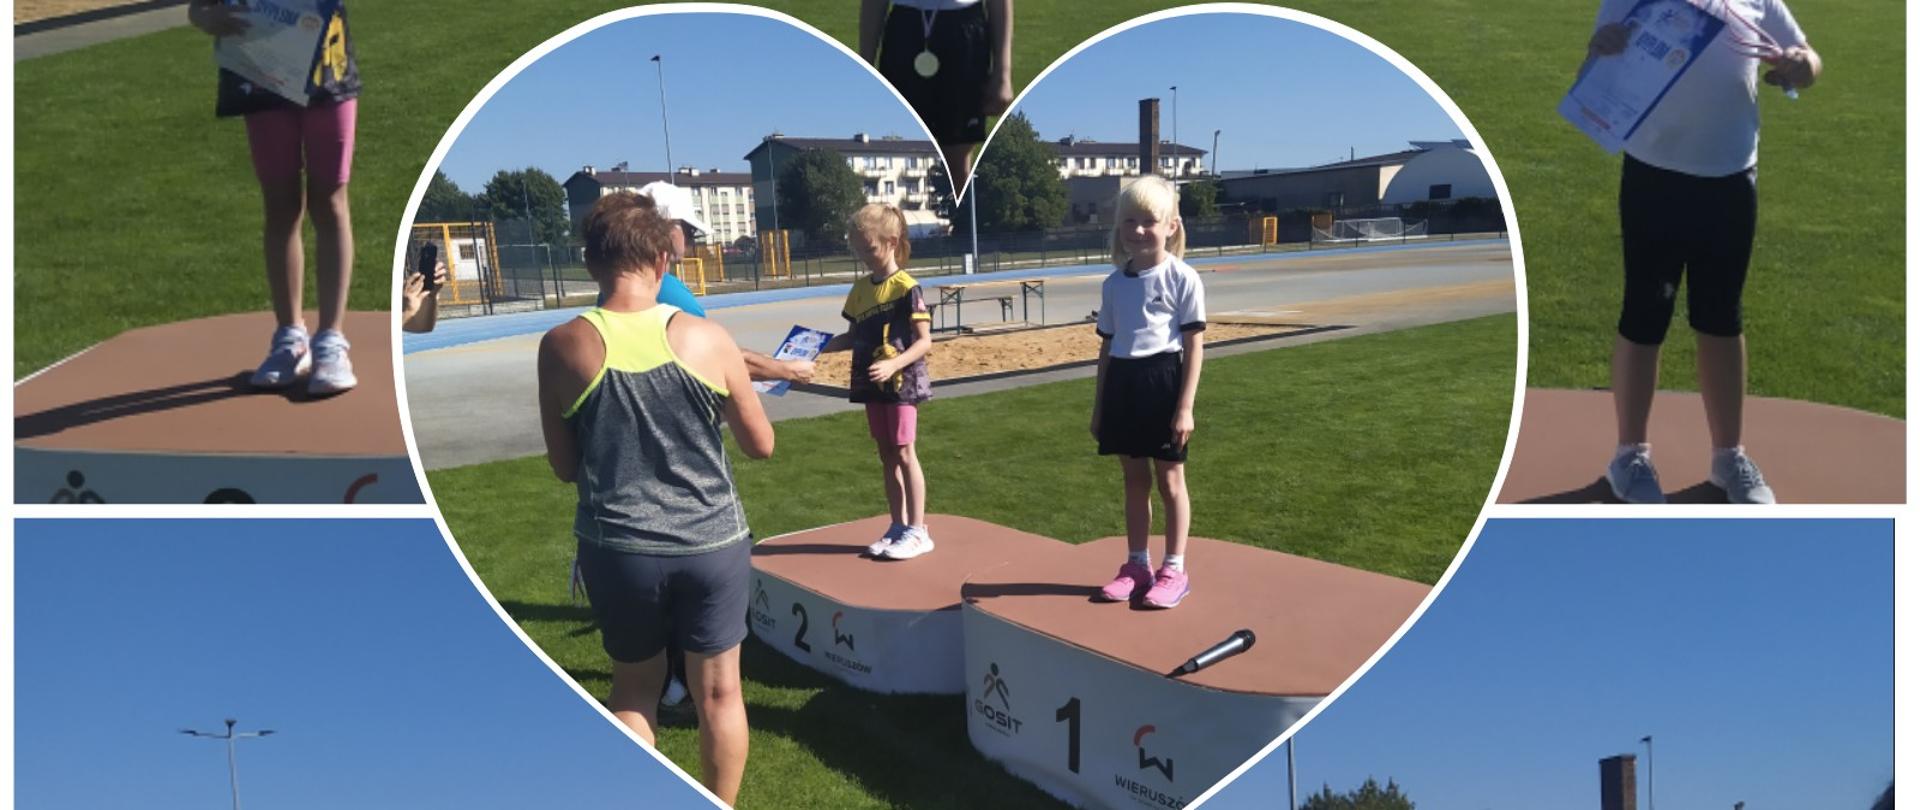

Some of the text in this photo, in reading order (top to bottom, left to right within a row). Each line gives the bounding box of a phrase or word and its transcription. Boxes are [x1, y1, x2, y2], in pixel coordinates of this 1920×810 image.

[792, 602, 811, 653] 2
[975, 699, 1023, 734] GOSIT
[1056, 697, 1081, 774] 1
